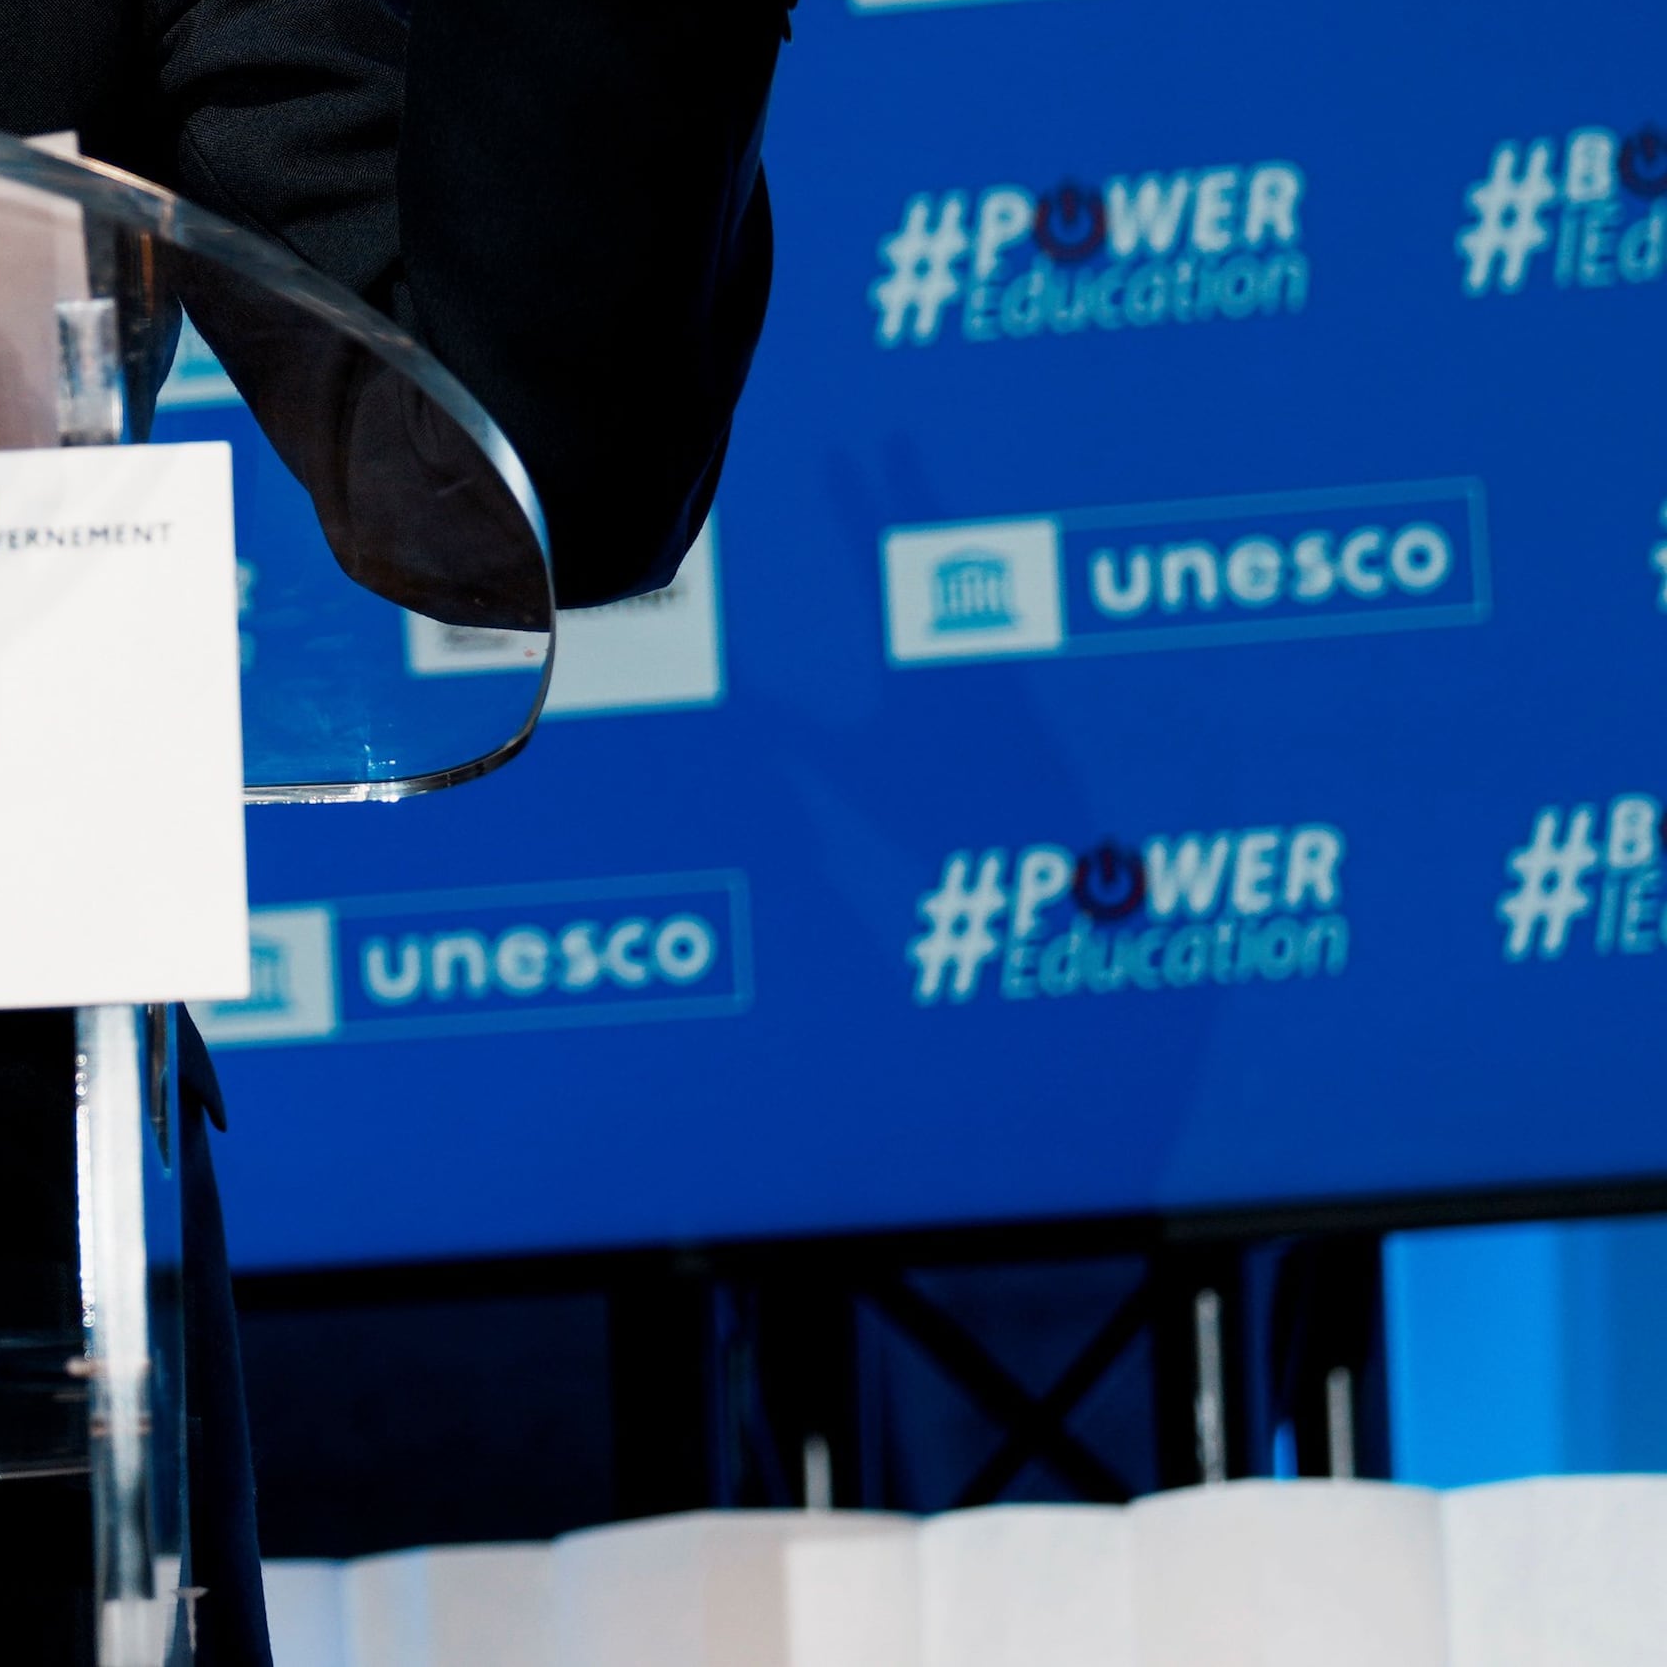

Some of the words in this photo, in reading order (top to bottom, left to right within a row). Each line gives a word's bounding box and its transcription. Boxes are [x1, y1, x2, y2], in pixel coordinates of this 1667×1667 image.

[966, 255, 1304, 335] Education
[1093, 525, 1448, 613] unesco
[365, 916, 710, 1001] unesco
[1006, 916, 1346, 995] Education
